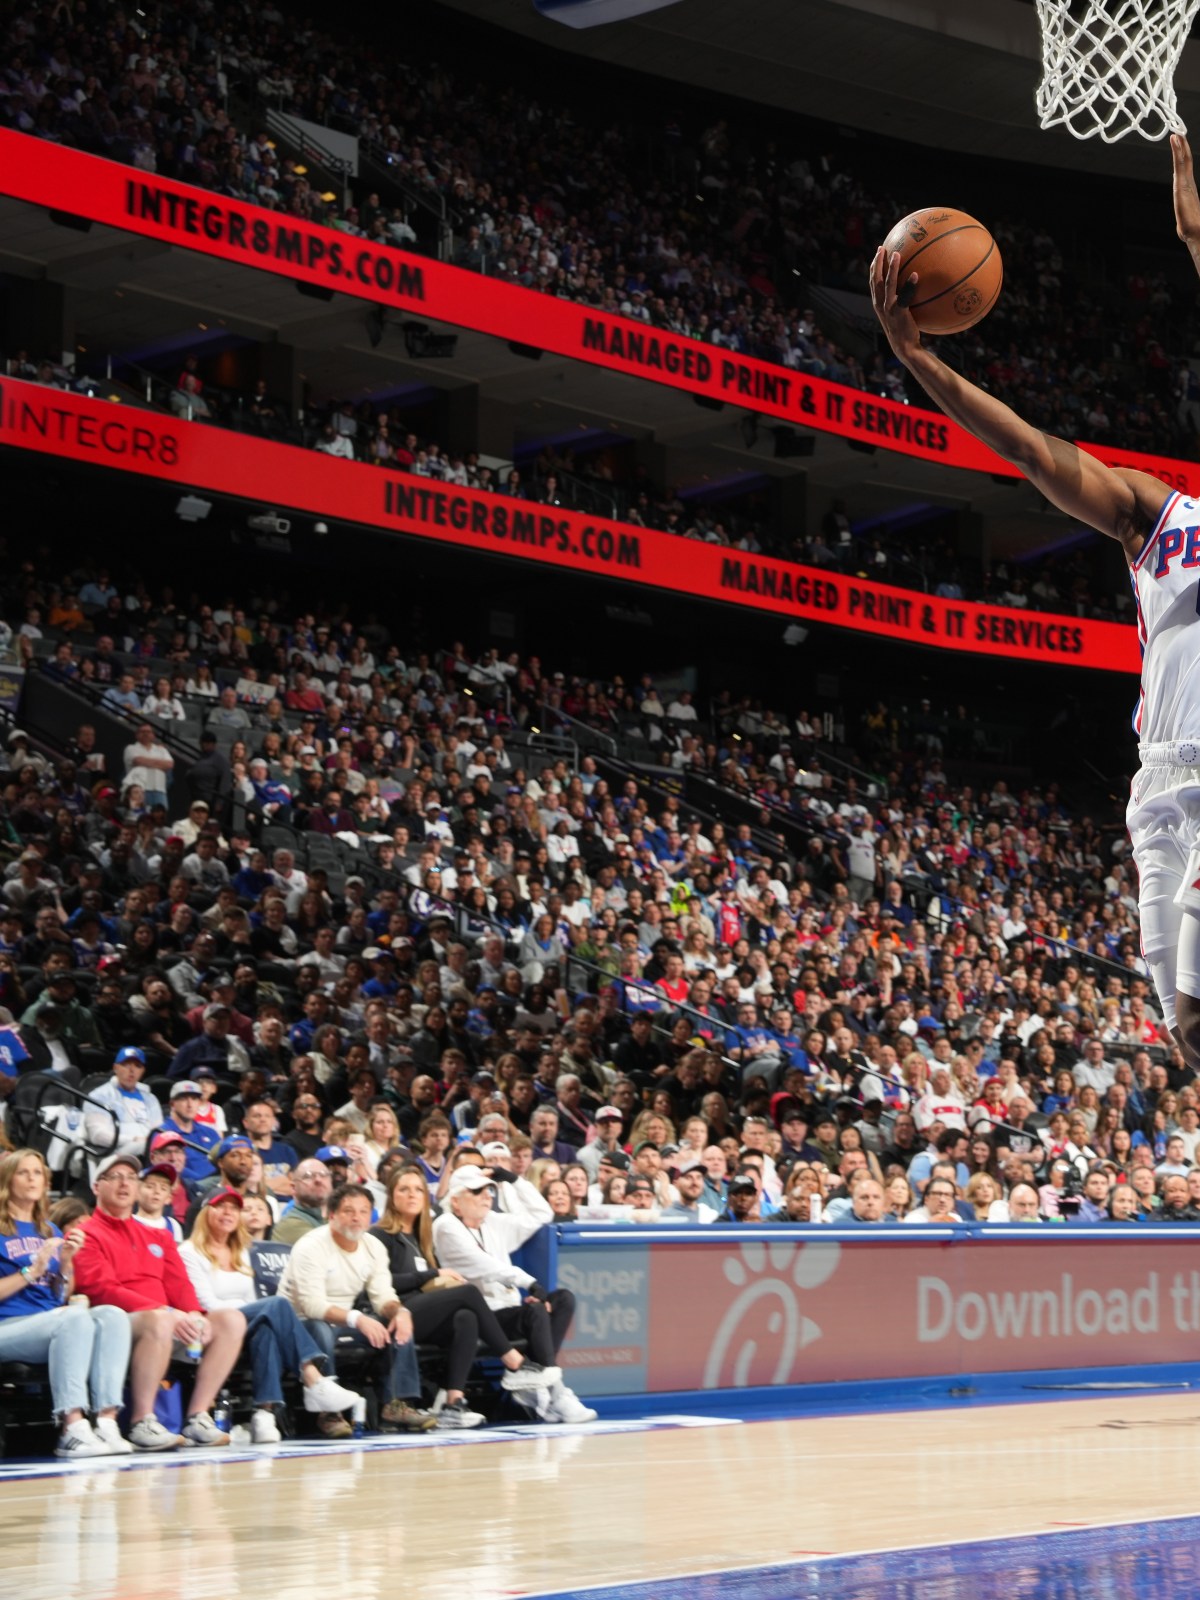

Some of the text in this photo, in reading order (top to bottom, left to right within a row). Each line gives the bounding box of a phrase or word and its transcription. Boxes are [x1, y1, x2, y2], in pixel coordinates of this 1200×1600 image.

[126, 179, 426, 301] INTEGR8MPS.COM
[582, 317, 949, 451] MANAGED PRINT & IT SERVICES
[9, 398, 179, 466] INTEGR8
[384, 480, 641, 568] INTEGR8MPS.COM
[720, 558, 1083, 654] MANAGED PRINT & IT SERVICES
[557, 1263, 645, 1302] Super
[579, 1301, 641, 1341] Lyte
[916, 1271, 1160, 1343] Download
